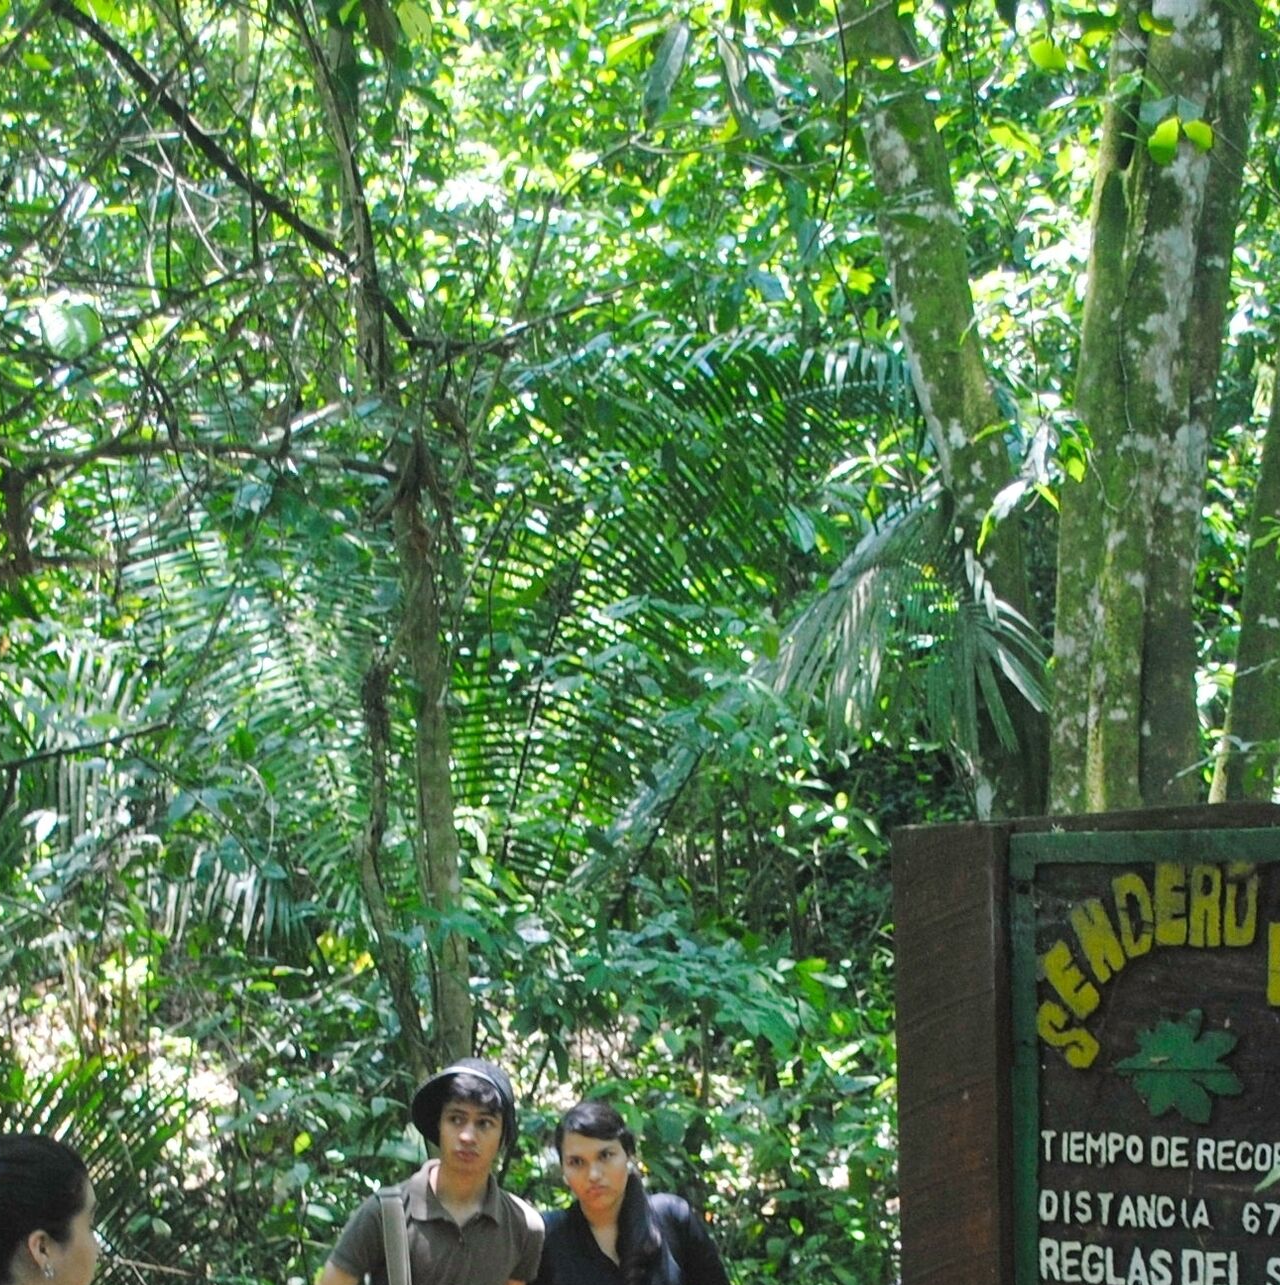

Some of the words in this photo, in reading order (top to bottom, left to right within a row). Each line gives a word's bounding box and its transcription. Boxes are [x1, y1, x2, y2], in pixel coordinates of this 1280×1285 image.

[1040, 1129, 1144, 1168] TIEMPO
[1150, 1135, 1190, 1168] DE
[1038, 1189, 1213, 1229] DISTANCIA
